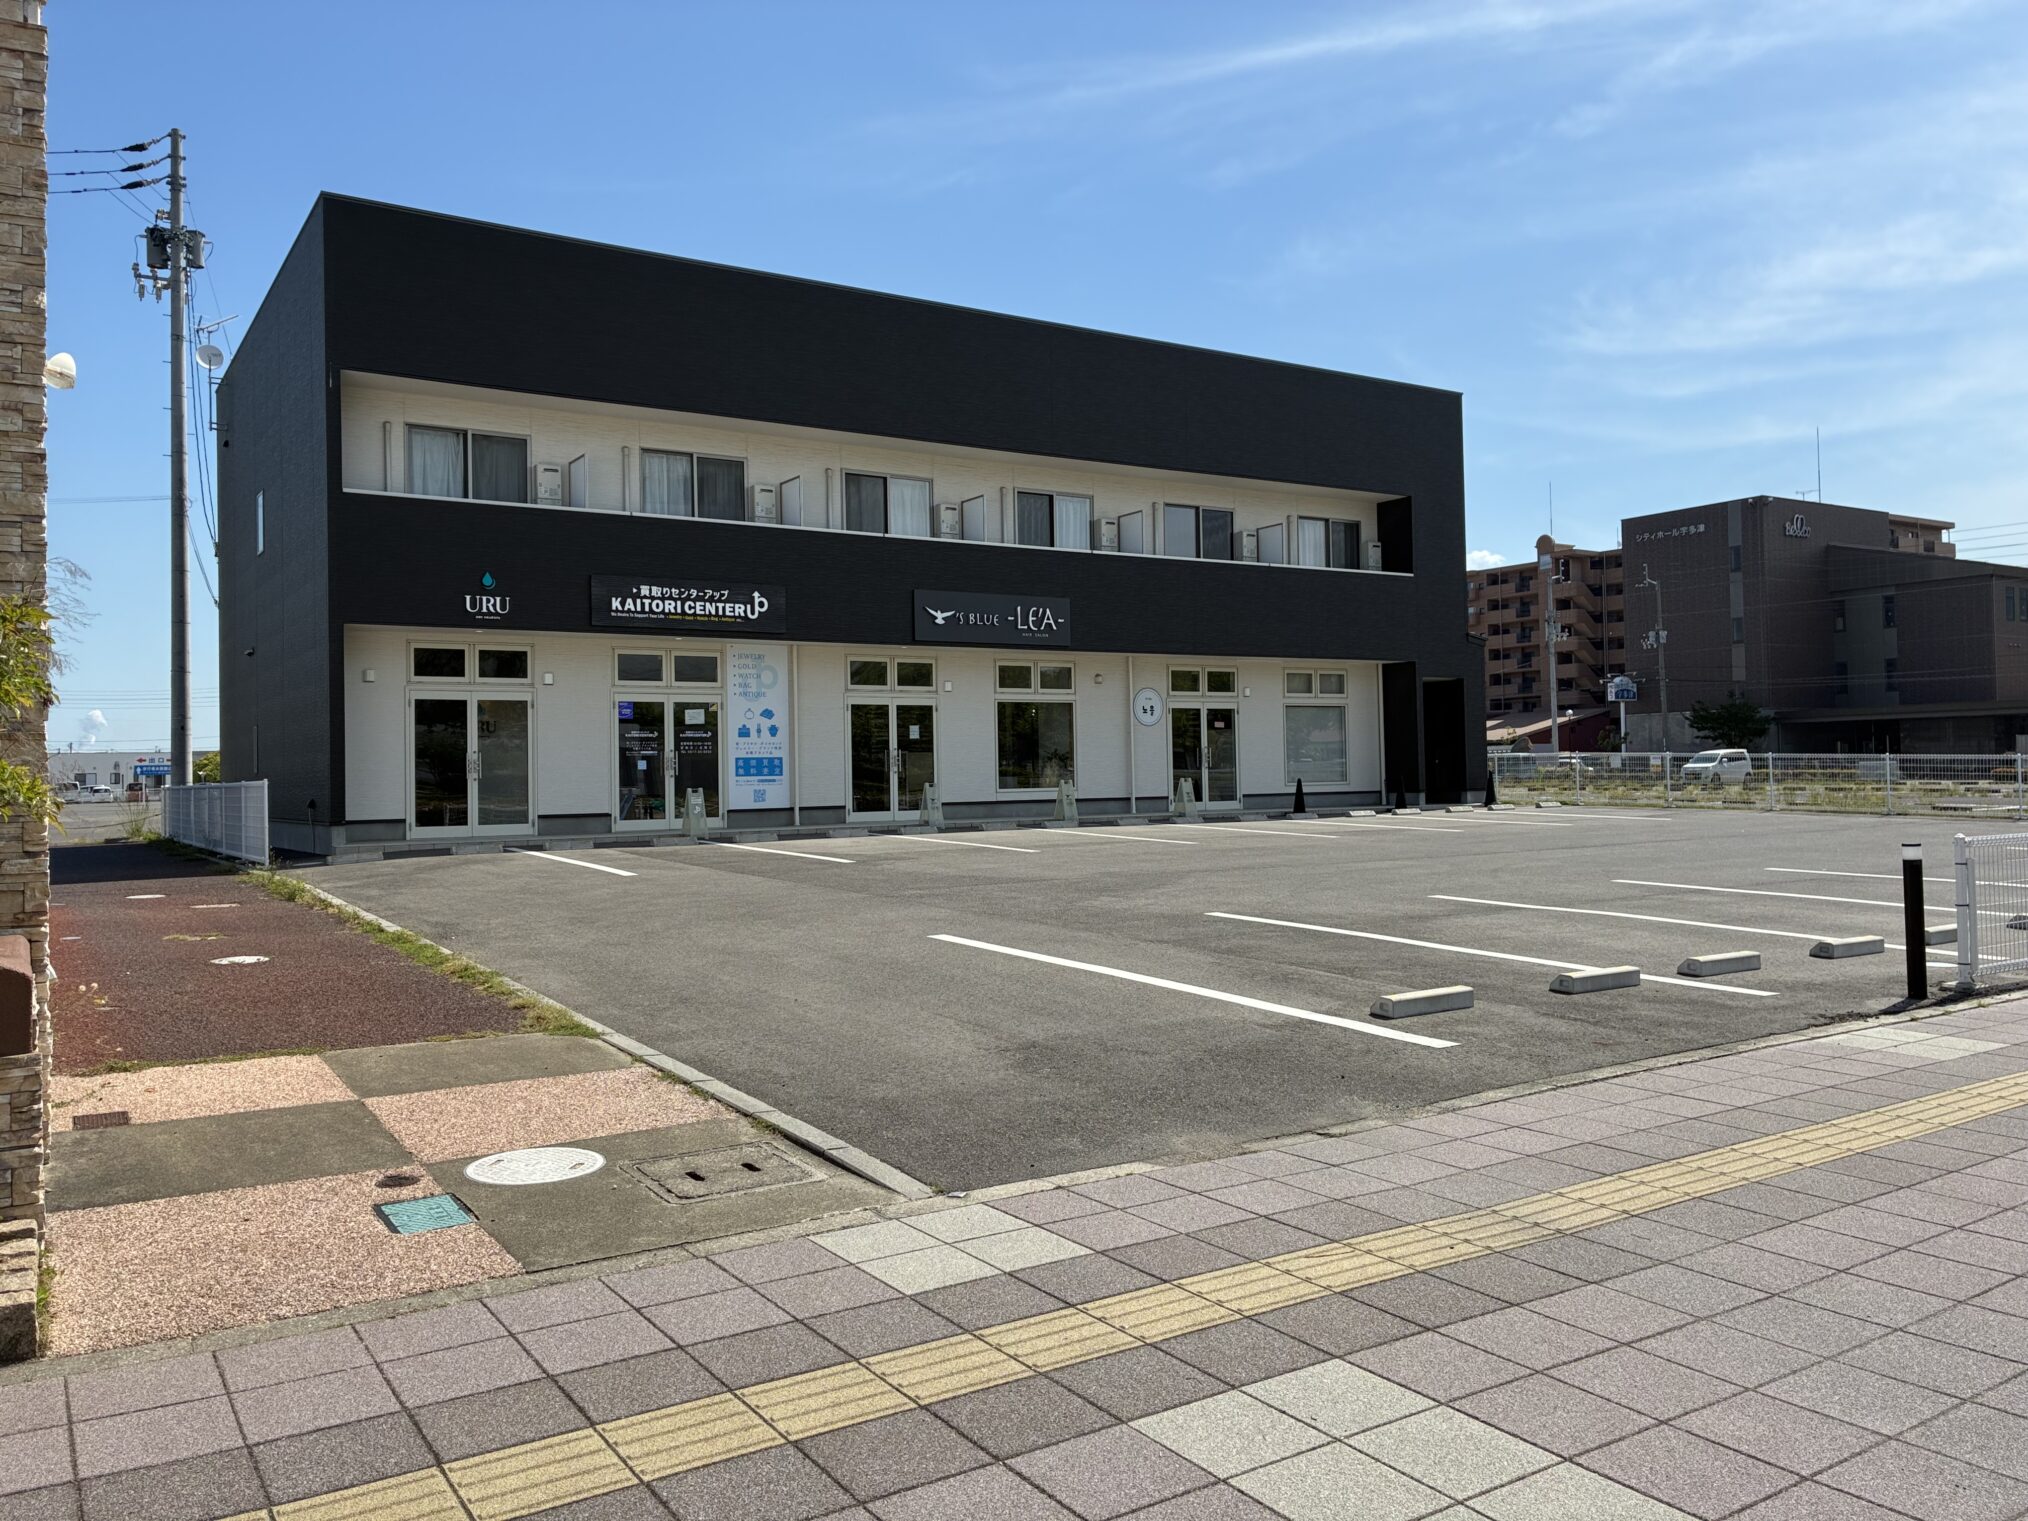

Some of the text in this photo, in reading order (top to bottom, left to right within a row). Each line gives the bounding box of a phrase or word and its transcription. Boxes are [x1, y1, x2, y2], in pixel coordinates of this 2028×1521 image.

[639, 585, 729, 600] 買取りセンターアップ
[464, 595, 510, 614] URU
[611, 597, 681, 613] KAITORI
[684, 601, 745, 616] CENTER
[969, 613, 999, 626] BLUE
